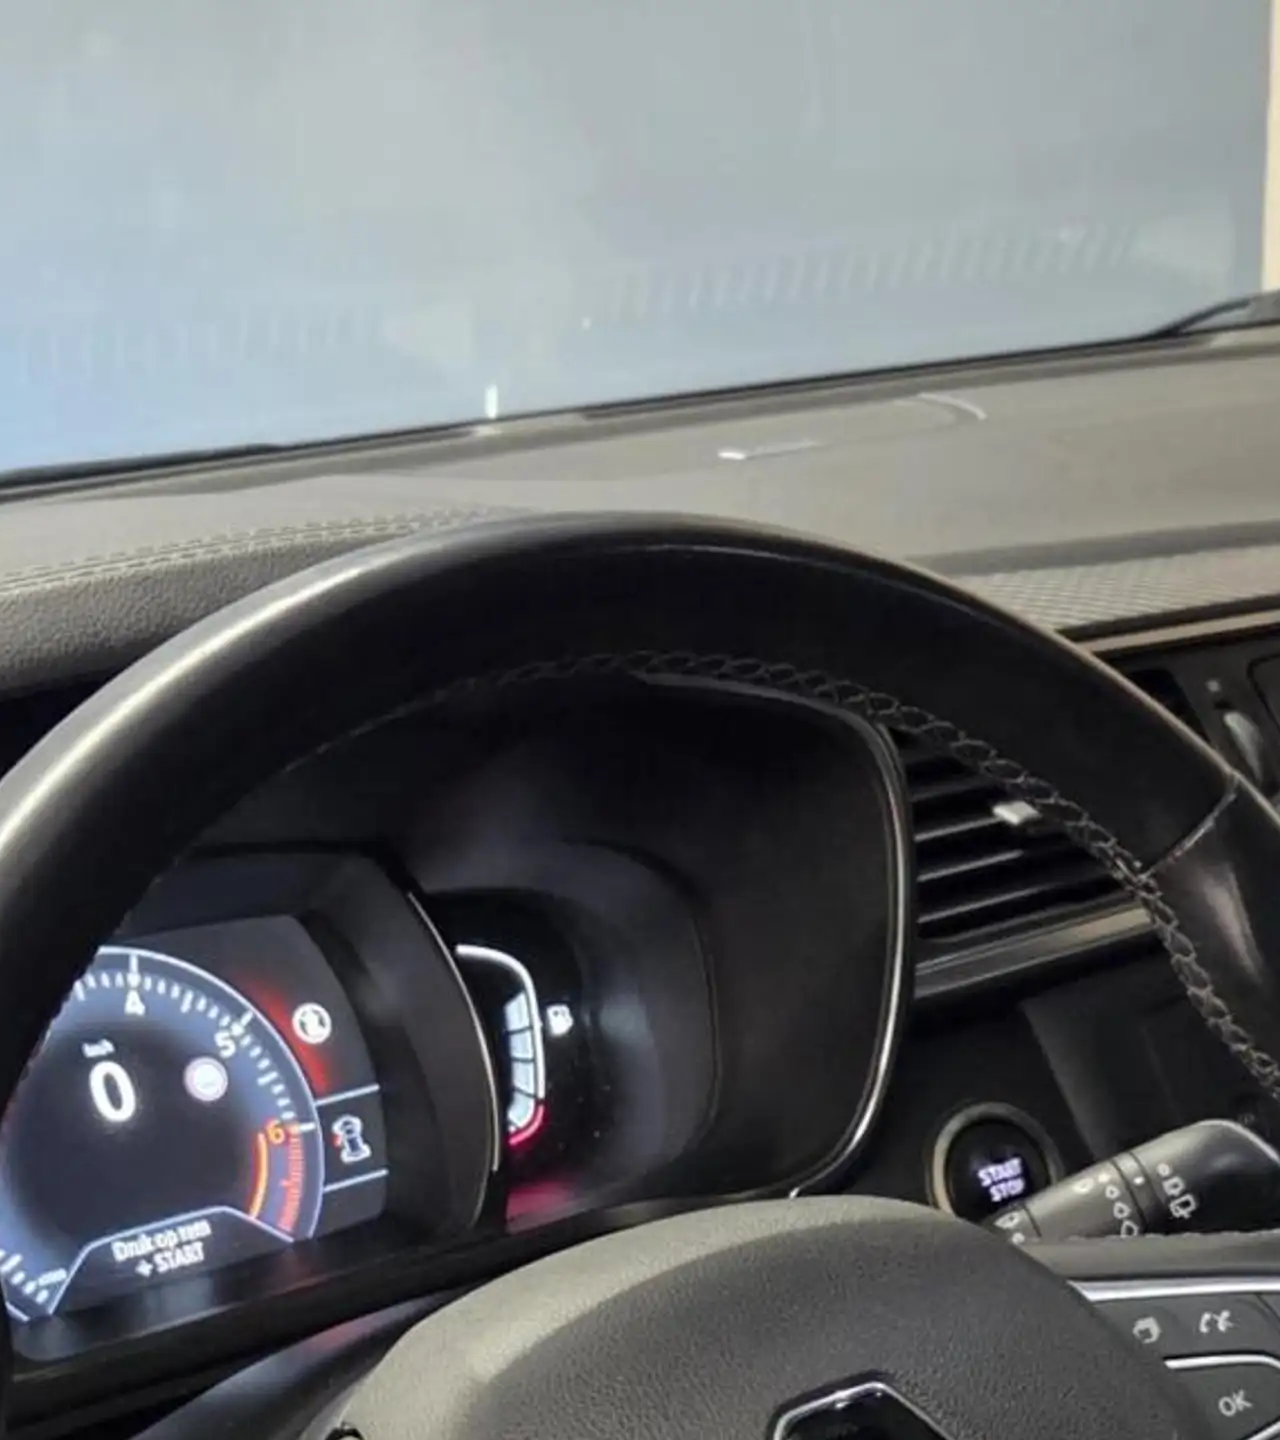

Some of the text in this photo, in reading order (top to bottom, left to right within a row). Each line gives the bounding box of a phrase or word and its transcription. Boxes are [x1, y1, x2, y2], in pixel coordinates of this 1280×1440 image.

[124, 989, 146, 1016] 4
[214, 1031, 237, 1060] 5
[88, 1060, 137, 1124] 0
[266, 1119, 285, 1145] 6
[977, 1156, 1023, 1188] START
[989, 1177, 1026, 1203] STOP
[152, 1241, 206, 1274] START
[1218, 1387, 1253, 1418] OK
